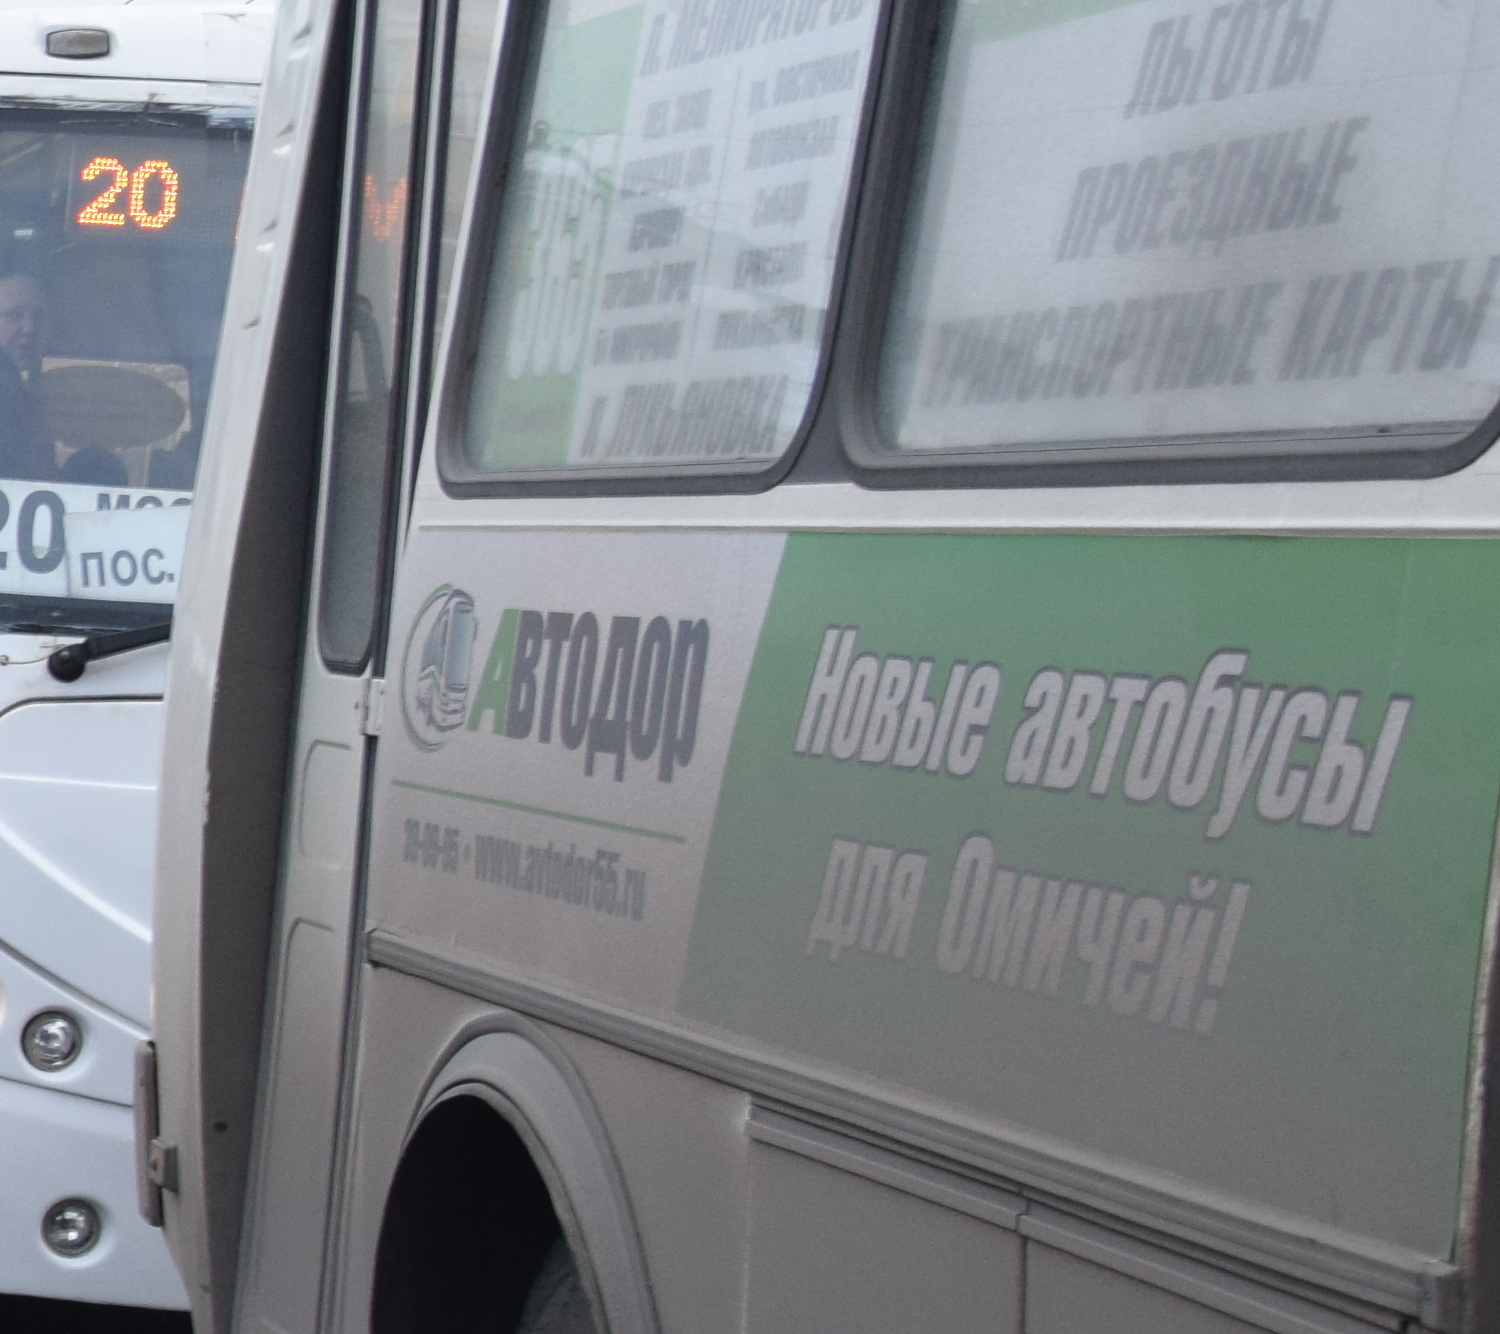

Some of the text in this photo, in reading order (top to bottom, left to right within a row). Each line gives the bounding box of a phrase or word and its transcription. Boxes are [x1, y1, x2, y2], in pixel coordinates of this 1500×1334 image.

[77, 157, 180, 231] 20
[1055, 116, 1372, 263] ПРОЕЗДНЫЕ
[793, 624, 1416, 838] Новые автобусы
[806, 830, 1252, 1039] для Омичей!
